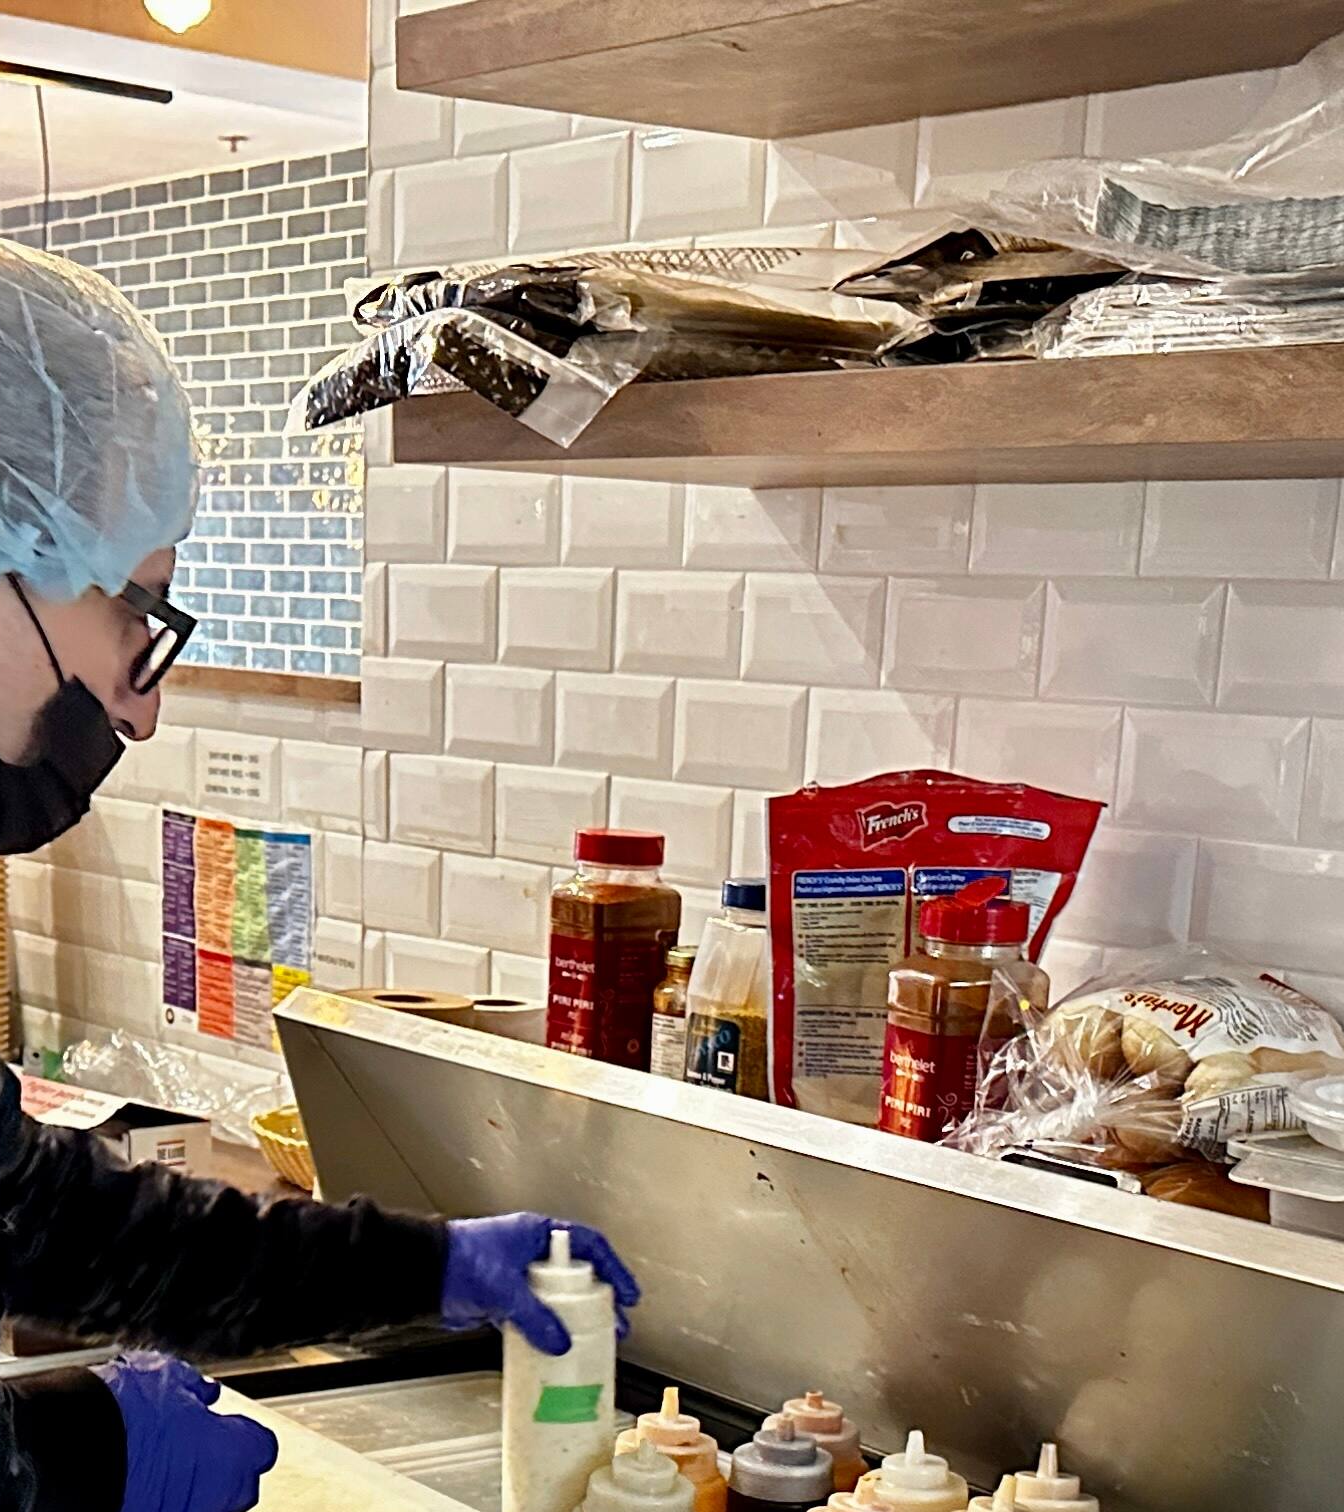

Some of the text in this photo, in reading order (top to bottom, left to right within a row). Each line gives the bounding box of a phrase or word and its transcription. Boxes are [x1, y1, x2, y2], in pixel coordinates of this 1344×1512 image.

[867, 808, 919, 836] French's
[1124, 991, 1214, 1039] Martin's
[890, 1049, 936, 1074] berthelet
[885, 1095, 931, 1119] PIRI PIRI
